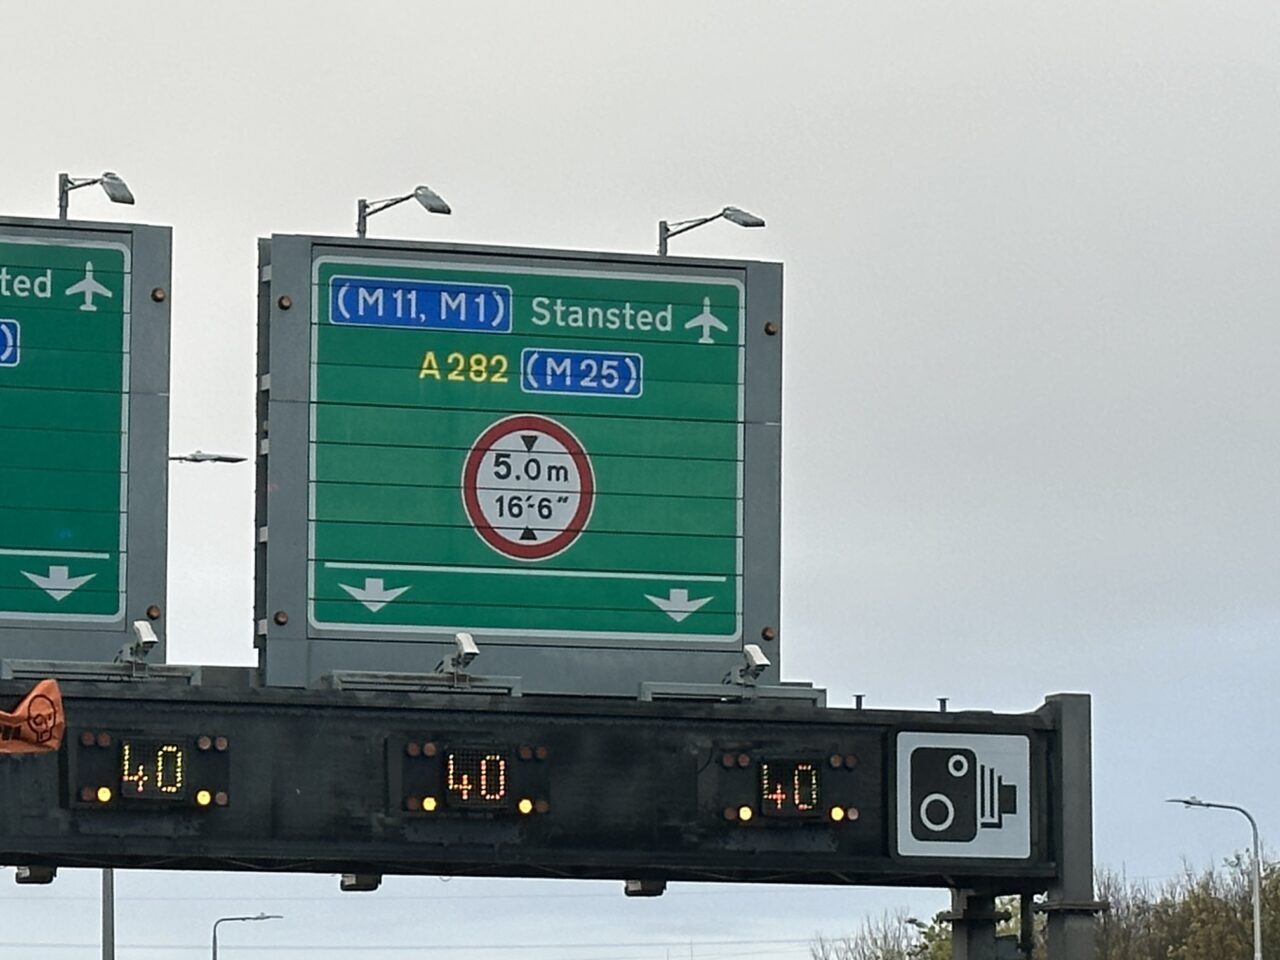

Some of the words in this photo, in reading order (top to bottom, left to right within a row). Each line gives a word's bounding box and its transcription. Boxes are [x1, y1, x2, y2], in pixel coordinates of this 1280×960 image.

[530, 297, 672, 331] Stansted
[419, 350, 509, 383] A282
[122, 743, 183, 794] 40
[448, 753, 506, 801] 40
[762, 763, 818, 811] 40
